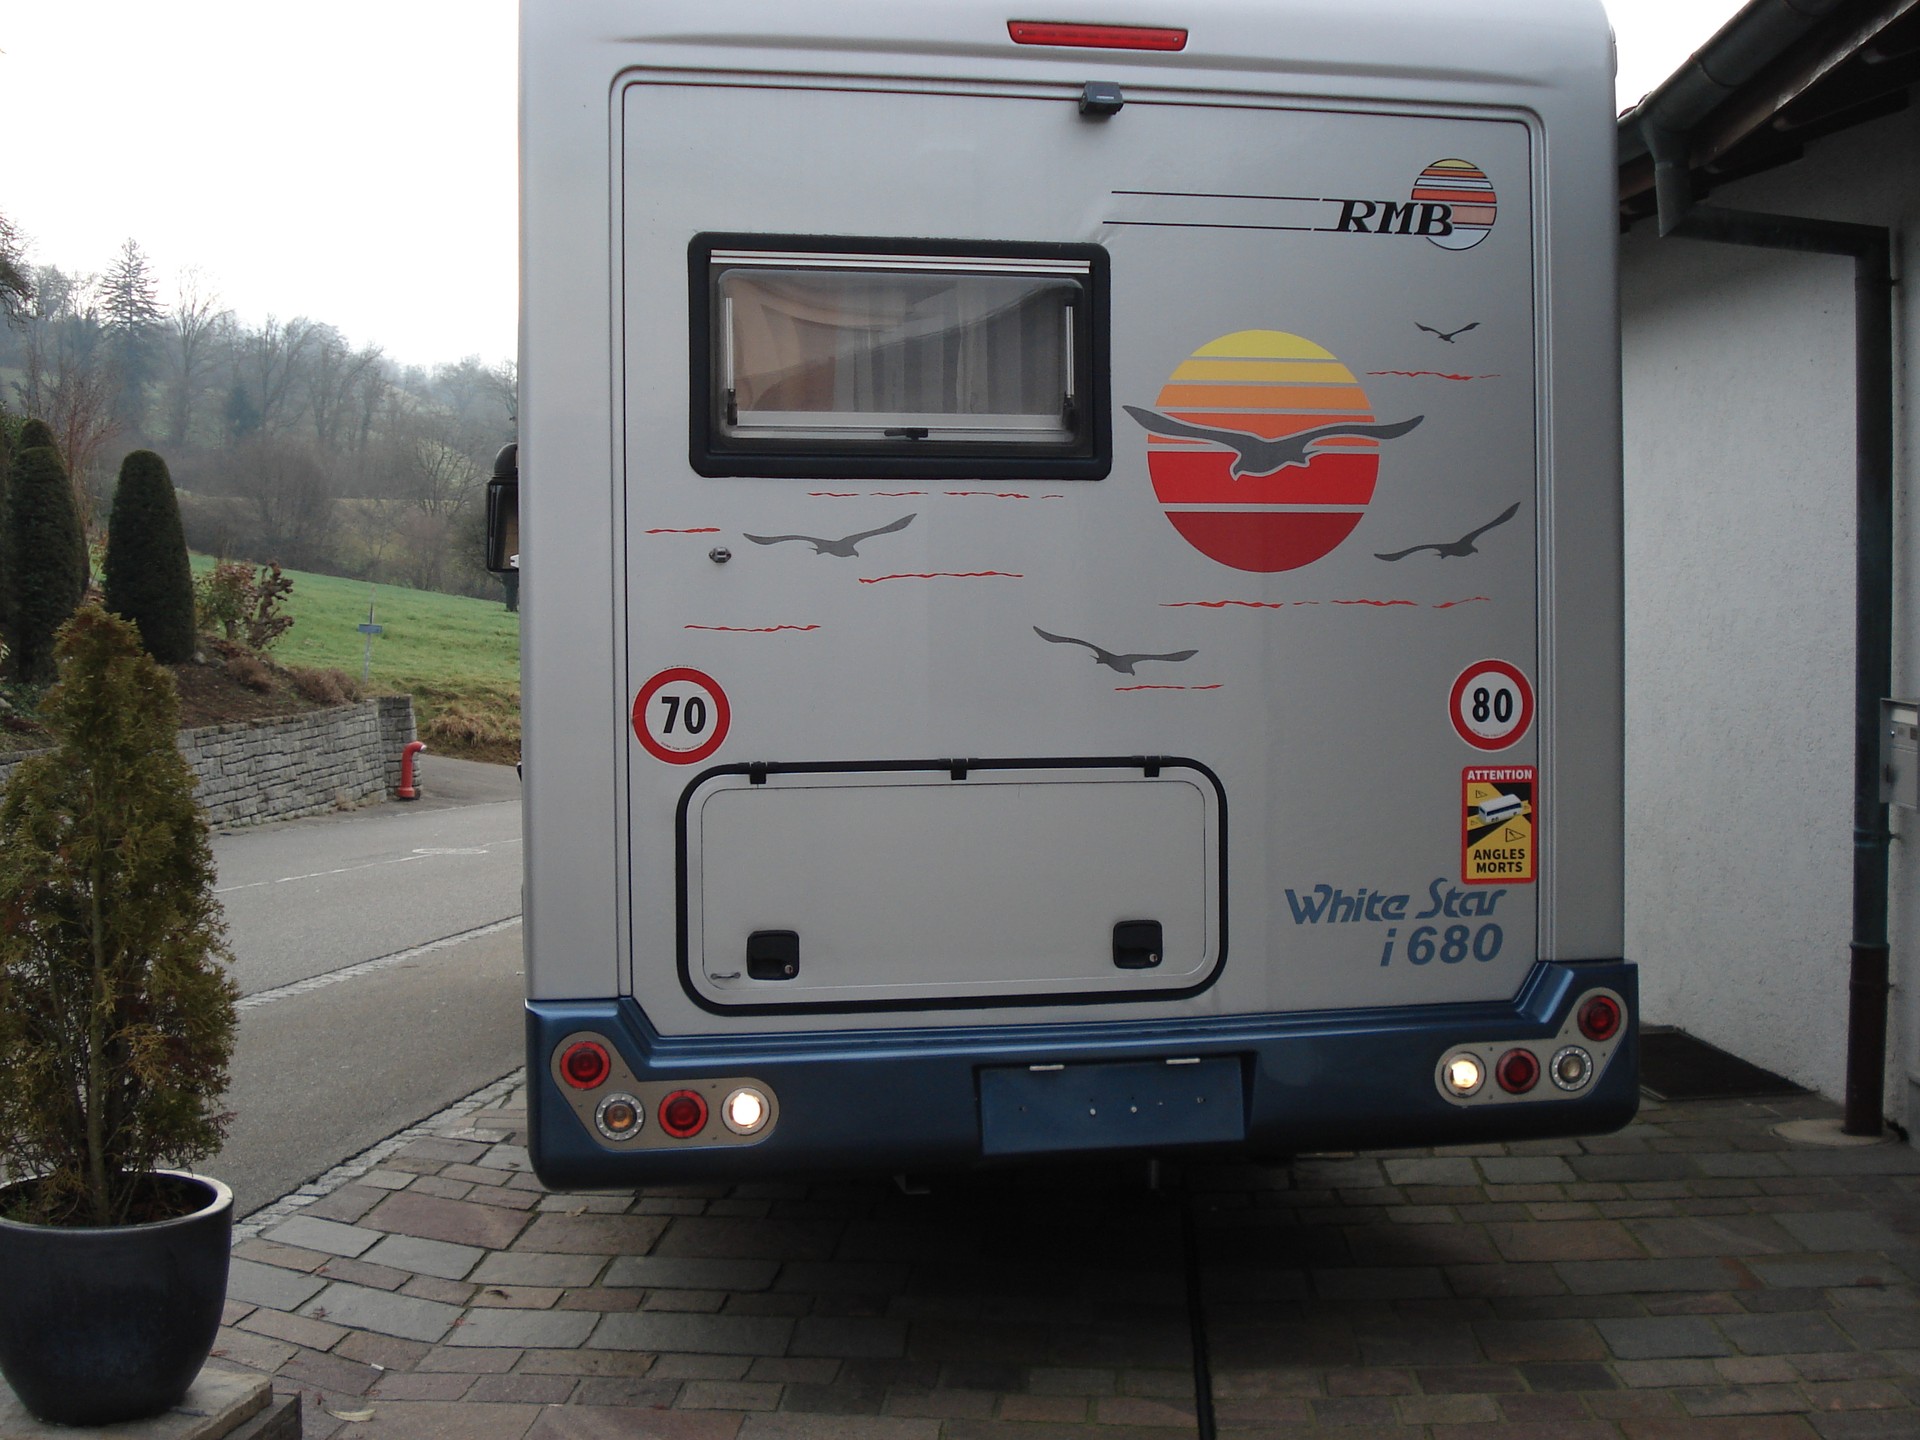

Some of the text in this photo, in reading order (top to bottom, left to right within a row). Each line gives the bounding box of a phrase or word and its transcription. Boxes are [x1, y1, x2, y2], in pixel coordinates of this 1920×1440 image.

[1335, 199, 1453, 236] RMB
[661, 696, 706, 734] 70
[1472, 687, 1513, 723] 80
[1467, 769, 1532, 781] ATTENTION
[1473, 848, 1526, 861] ANGLES
[1476, 861, 1523, 874] MORTS
[1284, 877, 1508, 925] White Star
